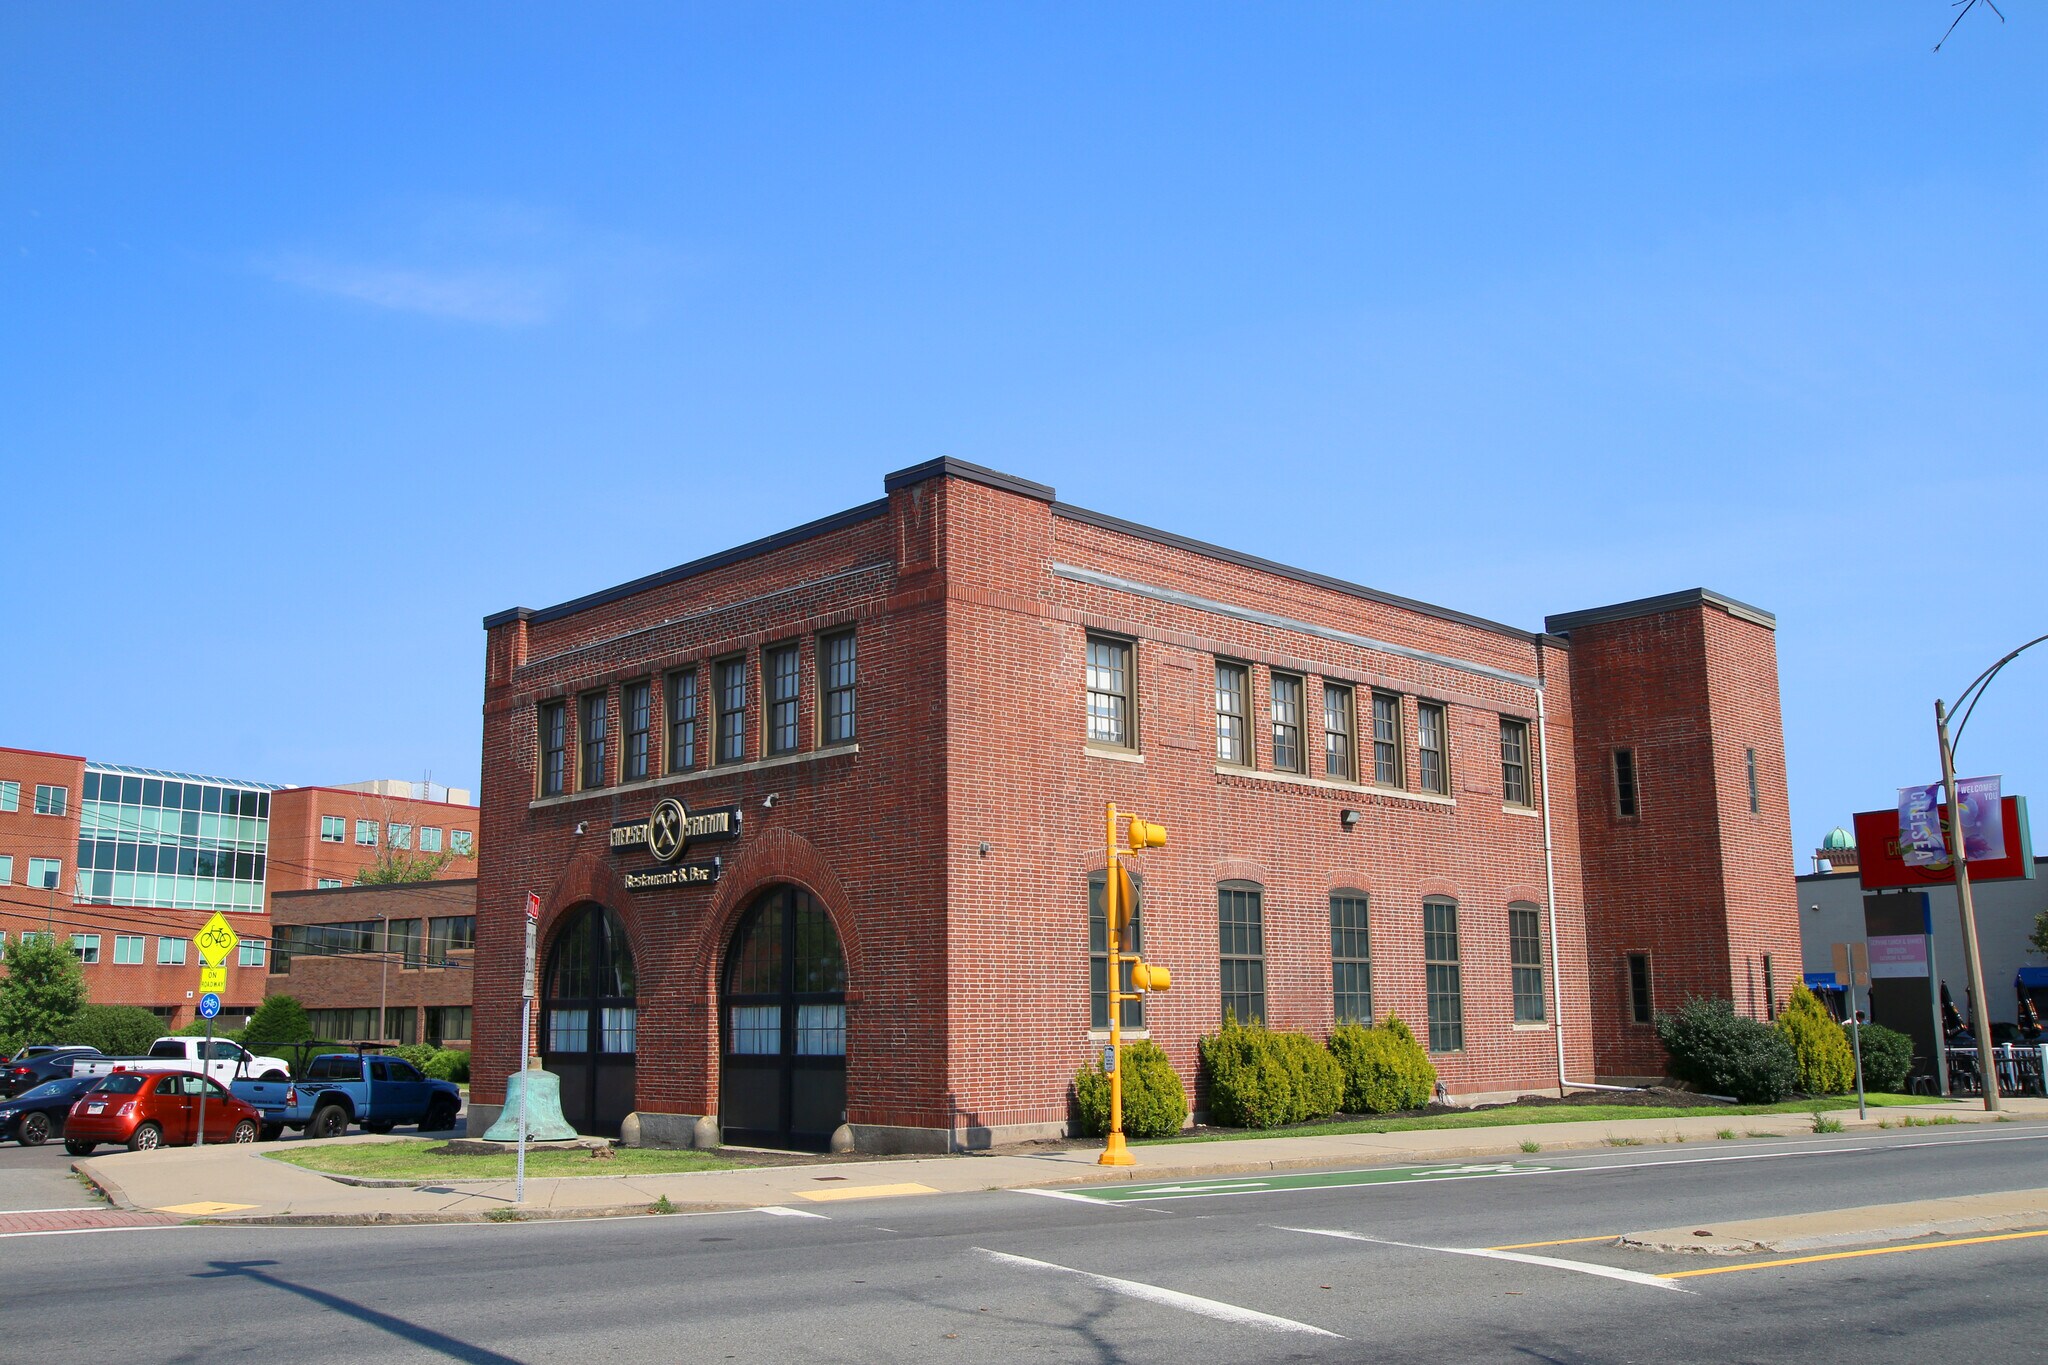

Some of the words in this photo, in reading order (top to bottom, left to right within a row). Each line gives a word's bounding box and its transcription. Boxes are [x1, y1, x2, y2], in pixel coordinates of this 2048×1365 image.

[1960, 782, 1998, 795] WELCOMES
[1984, 791, 1998, 801] YOU
[610, 824, 649, 846] CHELSEA
[684, 812, 729, 836] STATION
[1910, 791, 1935, 860] CHELSEA
[625, 870, 678, 888] Restaurant
[678, 867, 688, 882] &
[689, 866, 710, 881] Bar
